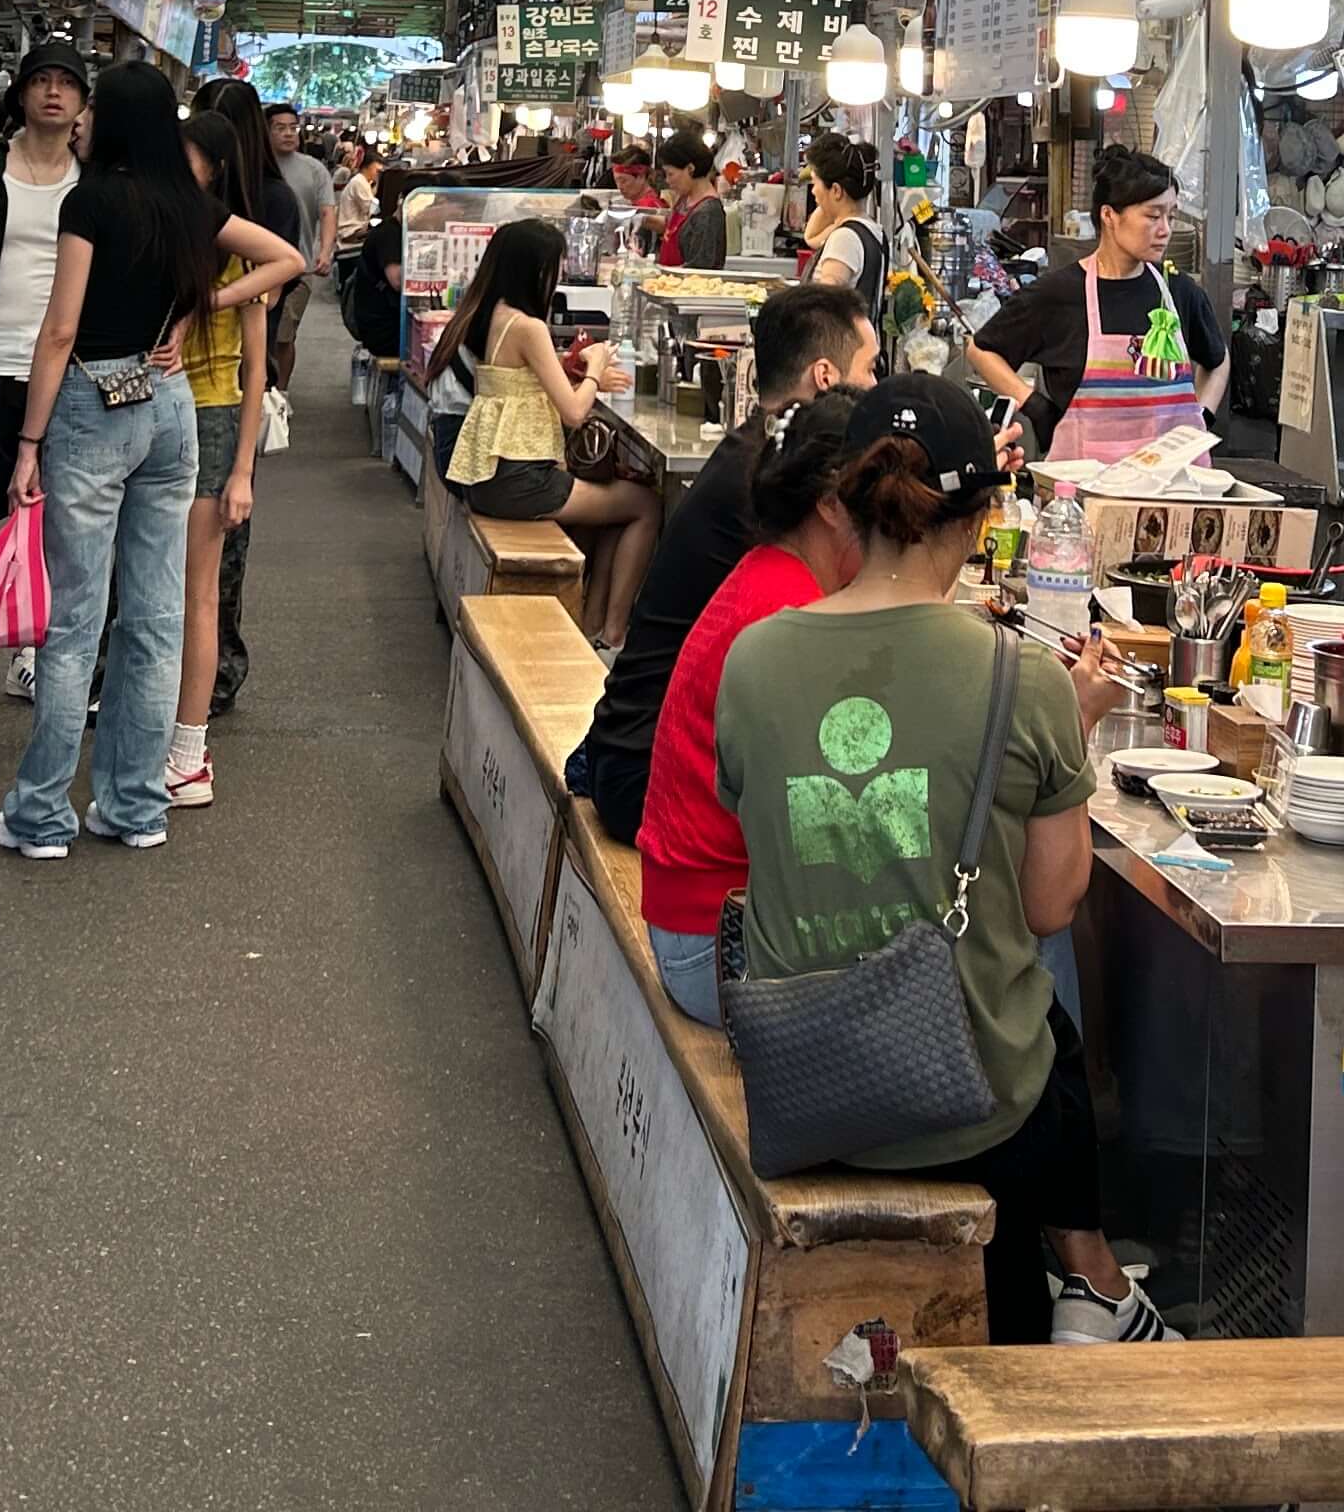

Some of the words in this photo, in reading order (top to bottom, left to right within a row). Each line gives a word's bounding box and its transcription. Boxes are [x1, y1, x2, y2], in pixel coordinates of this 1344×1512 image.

[525, 6, 595, 27] 강원도
[697, 0, 718, 18] 12
[502, 26, 515, 37] 13
[522, 28, 548, 40] 원조
[698, 24, 713, 40] 호
[525, 39, 599, 58] 손칼국수
[484, 71, 496, 82] 15
[500, 68, 571, 87] 생과일쥬스
